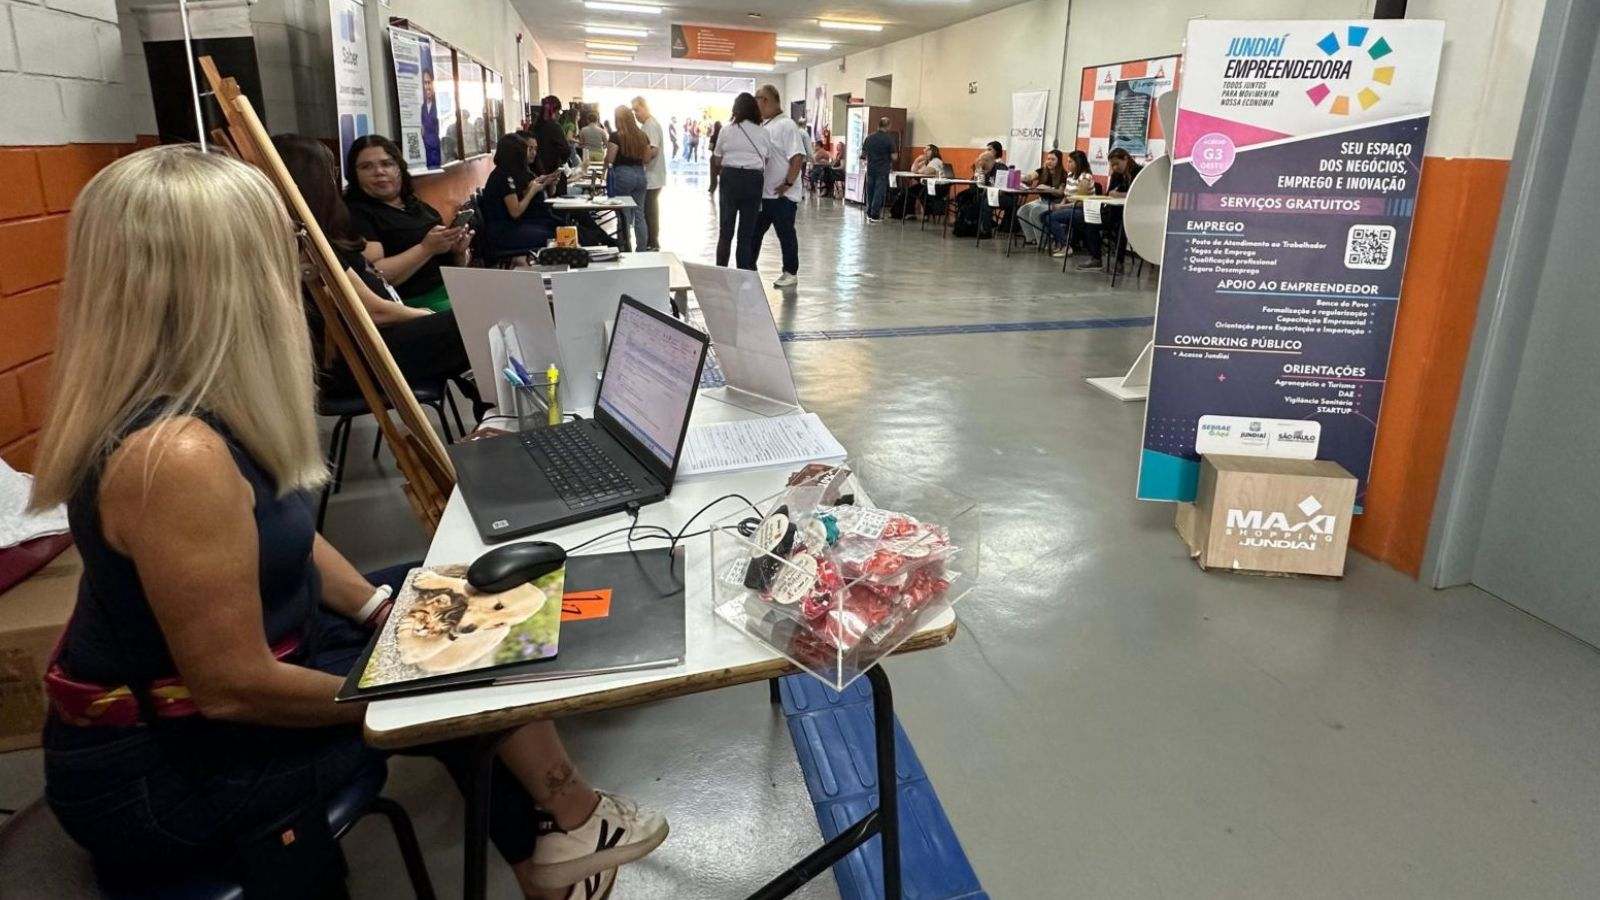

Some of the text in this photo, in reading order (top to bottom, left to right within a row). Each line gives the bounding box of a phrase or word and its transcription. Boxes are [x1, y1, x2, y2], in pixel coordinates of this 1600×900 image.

[1225, 34, 1290, 57] JUNDIAÍ
[1223, 60, 1352, 79] EMPREENDEDORA
[1239, 90, 1279, 98] MOVIMENTAR
[1220, 98, 1274, 107] NOSSA ECONOMIA
[1203, 148, 1224, 160] G3
[1340, 142, 1412, 159] SEU ESPAÇO
[1319, 157, 1408, 175] DOS NEGÓCIOS,
[1277, 175, 1406, 194] EMPREGO E INOVAÇÃO
[1220, 196, 1361, 211] SERVIÇOS GRATUITOS
[1186, 220, 1244, 232] EMPREGO
[1191, 238, 1211, 246] Posto
[1224, 239, 1270, 248] Atendimento
[1282, 240, 1327, 250] Trabalhador
[1190, 247, 1212, 256] Vagas
[1224, 249, 1256, 258] Emprego
[1189, 256, 1277, 267] Qualificação profissional
[1187, 265, 1260, 276] Seguro Desemprego
[1217, 279, 1379, 295] APOIO AO EMPREENDEDOR
[1262, 306, 1310, 316] Formalização
[1317, 308, 1368, 319] regularização
[1276, 315, 1366, 327] Capacitação Empresarial
[1215, 321, 1255, 331] Orientação
[1256, 324, 1273, 332] para
[1275, 323, 1315, 334] Exportação
[1323, 325, 1365, 336] Importação
[1174, 335, 1302, 350] COWORKING PÚBLICO
[1283, 363, 1367, 378] ORIENTAÇÕES
[1274, 379, 1320, 389] Agronegócio
[1327, 381, 1356, 389] Turismo
[1338, 390, 1354, 398] DAE
[1284, 396, 1319, 405] Vigilância
[1316, 406, 1352, 415] STARTUP
[1226, 504, 1336, 535] MAXI
[1225, 528, 1333, 542] SHOPPING
